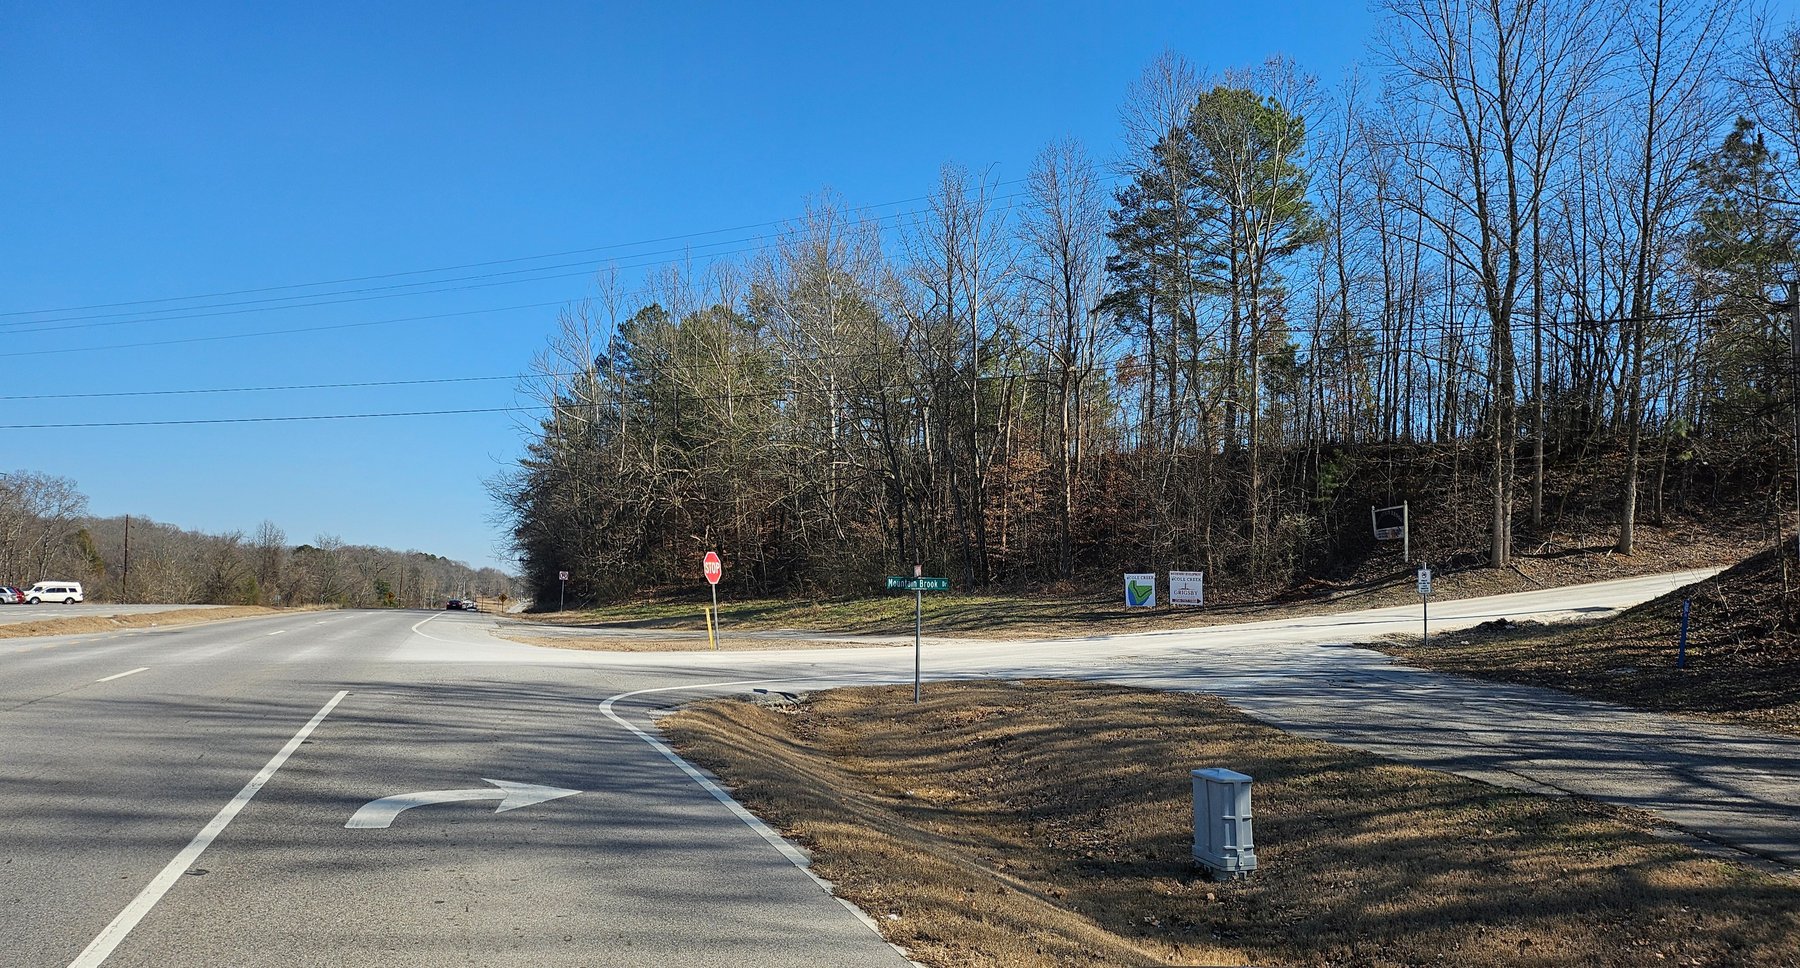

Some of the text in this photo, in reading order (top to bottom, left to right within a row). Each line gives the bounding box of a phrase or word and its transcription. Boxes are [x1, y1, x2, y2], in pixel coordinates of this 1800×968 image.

[705, 562, 720, 574] STOP
[888, 579, 917, 587] Mountain
[919, 579, 938, 588] Brook
